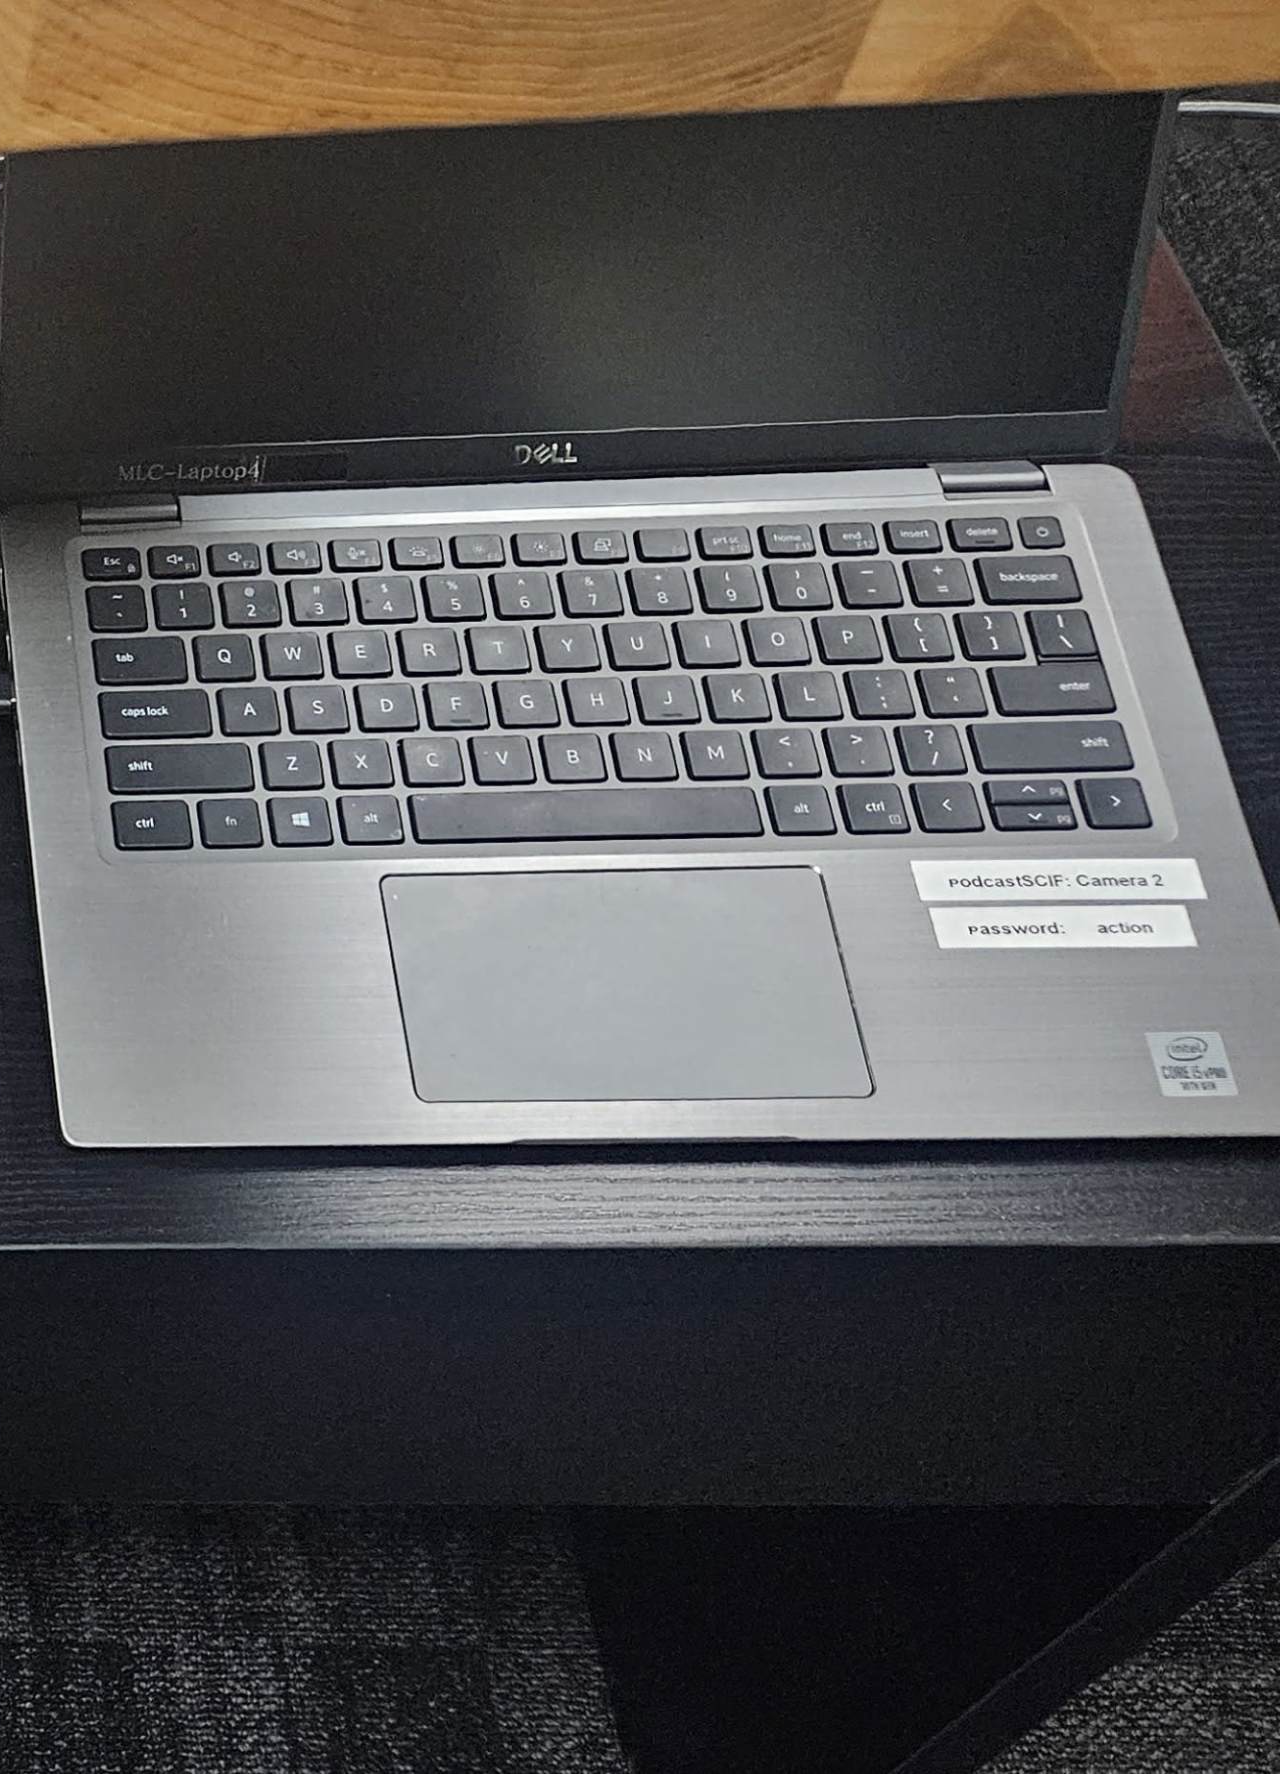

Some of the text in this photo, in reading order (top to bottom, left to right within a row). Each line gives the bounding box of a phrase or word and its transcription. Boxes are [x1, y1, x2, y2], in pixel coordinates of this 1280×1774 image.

[514, 442, 578, 465] DELL
[899, 527, 931, 540] insert
[103, 555, 122, 566] Esc
[998, 570, 1060, 585] backspace
[587, 593, 597, 606] 7
[656, 591, 669, 604] 8
[726, 588, 737, 602] 9
[796, 586, 808, 600] 0
[314, 602, 324, 615] 3
[382, 600, 393, 612] 4
[450, 598, 462, 611] 5
[519, 595, 531, 609] 6
[179, 607, 187, 619] 1
[246, 603, 257, 617] 2
[630, 636, 644, 651] U
[770, 631, 785, 647] O
[841, 629, 854, 644] P
[354, 644, 367, 659] E
[422, 642, 437, 657] R
[491, 640, 504, 655] T
[561, 638, 573, 652] Y
[115, 651, 134, 663] tab
[217, 648, 232, 664] Q
[283, 646, 302, 661] W
[1058, 678, 1091, 692] enter
[590, 692, 605, 707] H
[663, 690, 673, 705] J
[730, 688, 745, 703] K
[803, 686, 816, 702] L
[243, 702, 257, 716] A
[312, 700, 324, 715] S
[380, 698, 394, 713] D
[450, 696, 462, 711] F
[519, 694, 535, 710] G
[121, 703, 169, 719] caps lock
[425, 752, 439, 767] C
[494, 751, 508, 765] V
[565, 749, 580, 764] B
[637, 747, 653, 762] N
[706, 745, 725, 760] M
[127, 759, 154, 772] shift
[286, 756, 299, 771] Z
[354, 754, 369, 769] X
[793, 801, 810, 814] alt
[865, 800, 887, 813] ctrl
[135, 816, 156, 829] ctrl
[224, 814, 238, 826] fn
[363, 811, 380, 824] alt
[1075, 874, 1149, 887] Camera
[1151, 873, 1164, 887] 2
[1097, 921, 1154, 934] action
